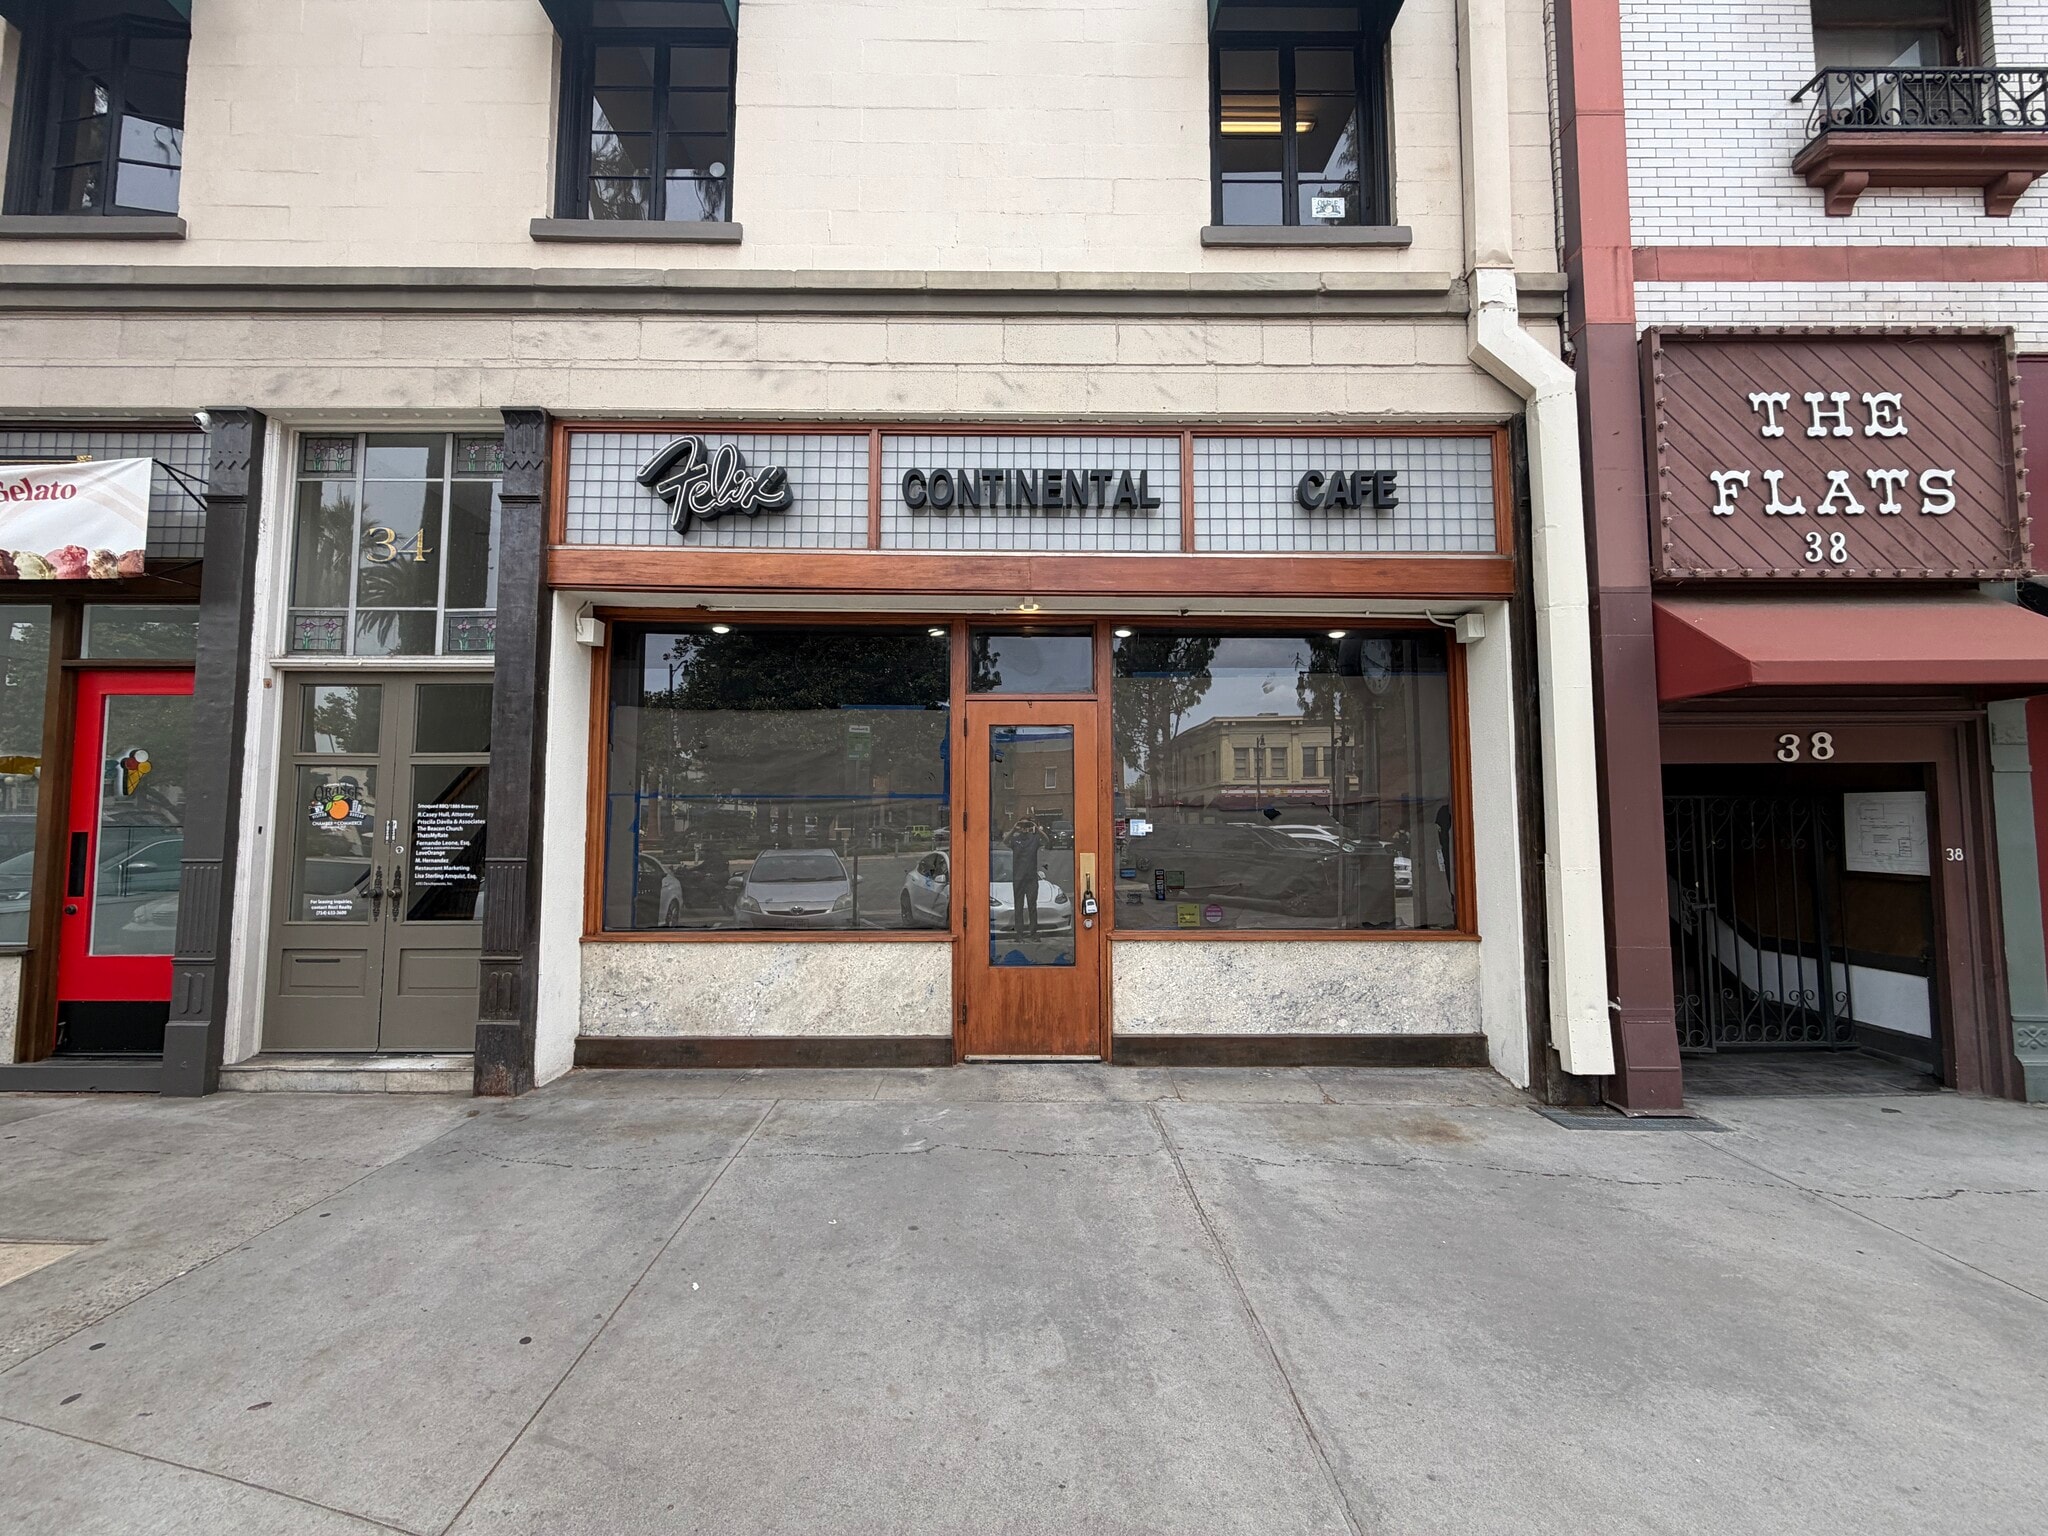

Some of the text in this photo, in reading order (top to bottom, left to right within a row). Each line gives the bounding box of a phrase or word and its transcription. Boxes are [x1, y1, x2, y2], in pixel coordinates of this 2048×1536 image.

[1748, 391, 1909, 437] THE
[636, 435, 1399, 535] Felix CONTINENTAL CAFE
[1709, 468, 1956, 516] FLATS
[366, 526, 434, 563] 34
[1804, 531, 1848, 563] 38
[1777, 731, 1835, 762] 38
[314, 785, 364, 802] ORANGE
[1945, 848, 1964, 861] 38
